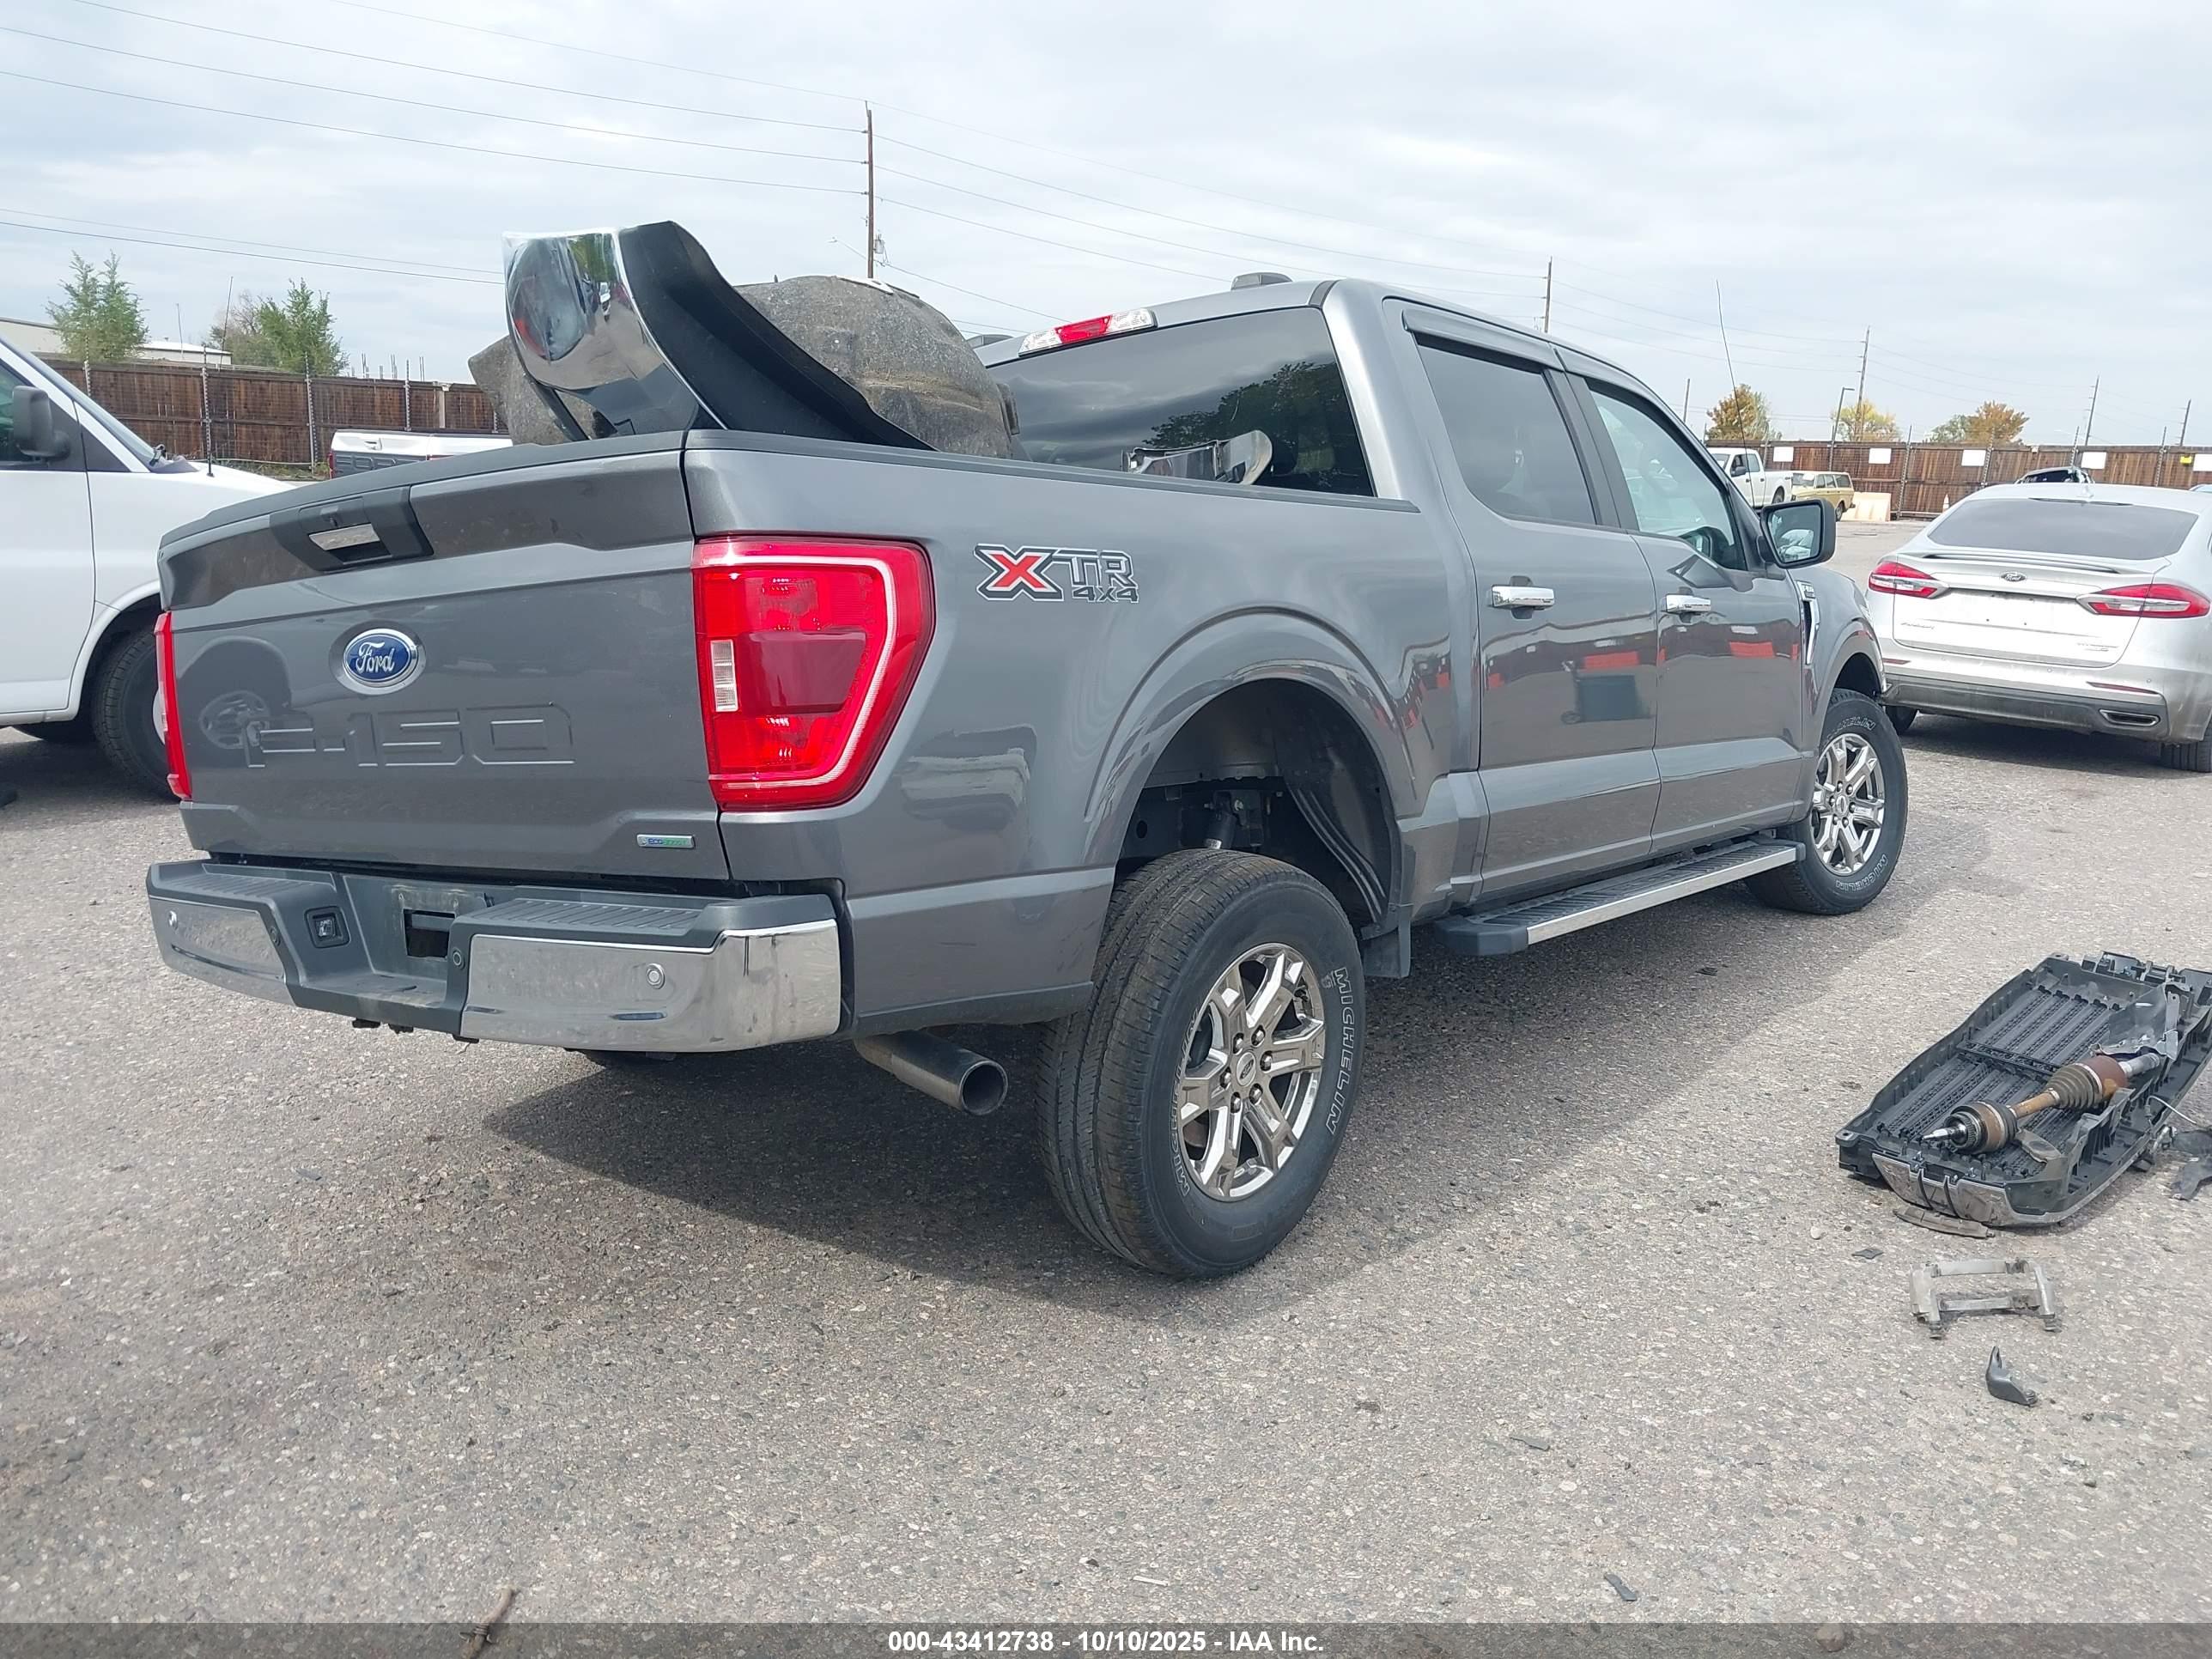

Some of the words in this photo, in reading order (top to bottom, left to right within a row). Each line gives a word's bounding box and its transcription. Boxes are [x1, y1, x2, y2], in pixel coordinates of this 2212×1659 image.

[974, 543, 1138, 602] XTR
[356, 641, 395, 674] Ford
[245, 705, 575, 769] F-150
[1835, 854, 1888, 891] MICHELIN
[1326, 967, 1355, 1135] MICHELIN
